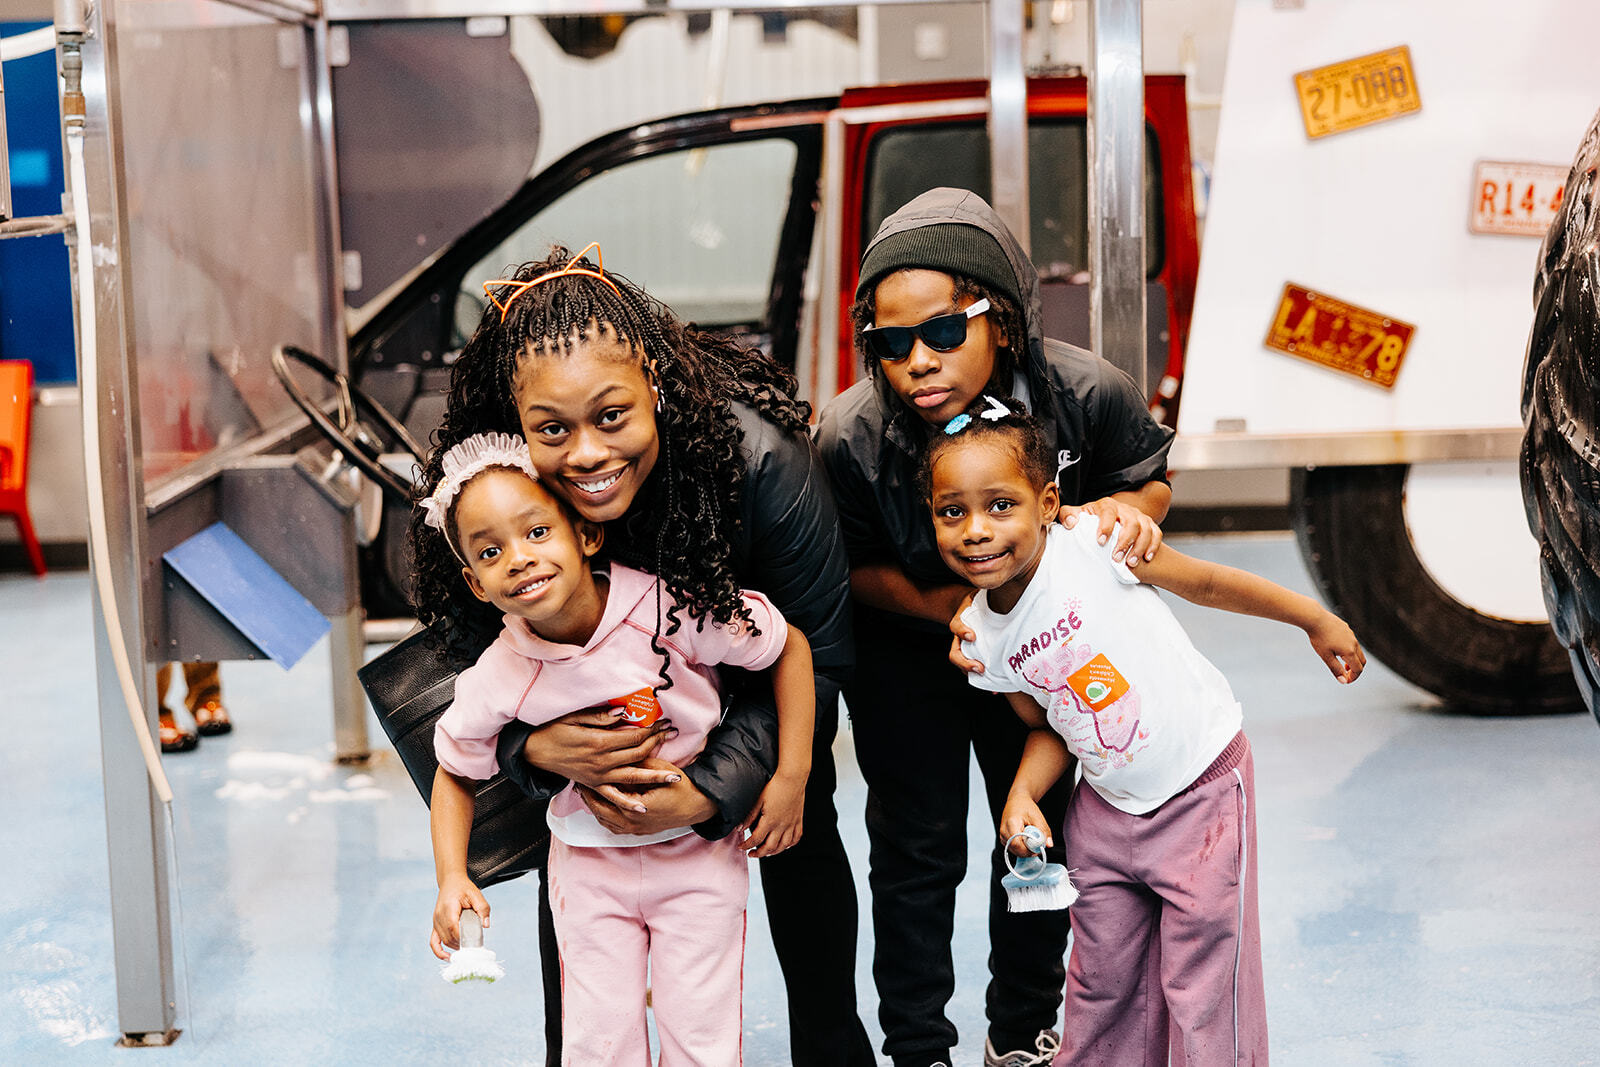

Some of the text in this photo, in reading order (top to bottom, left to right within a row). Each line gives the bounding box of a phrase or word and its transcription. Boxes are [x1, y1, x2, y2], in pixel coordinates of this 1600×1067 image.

[1305, 64, 1409, 121] 27-088
[1479, 180, 1565, 216] R14-4
[1008, 611, 1083, 674] PARADISE
